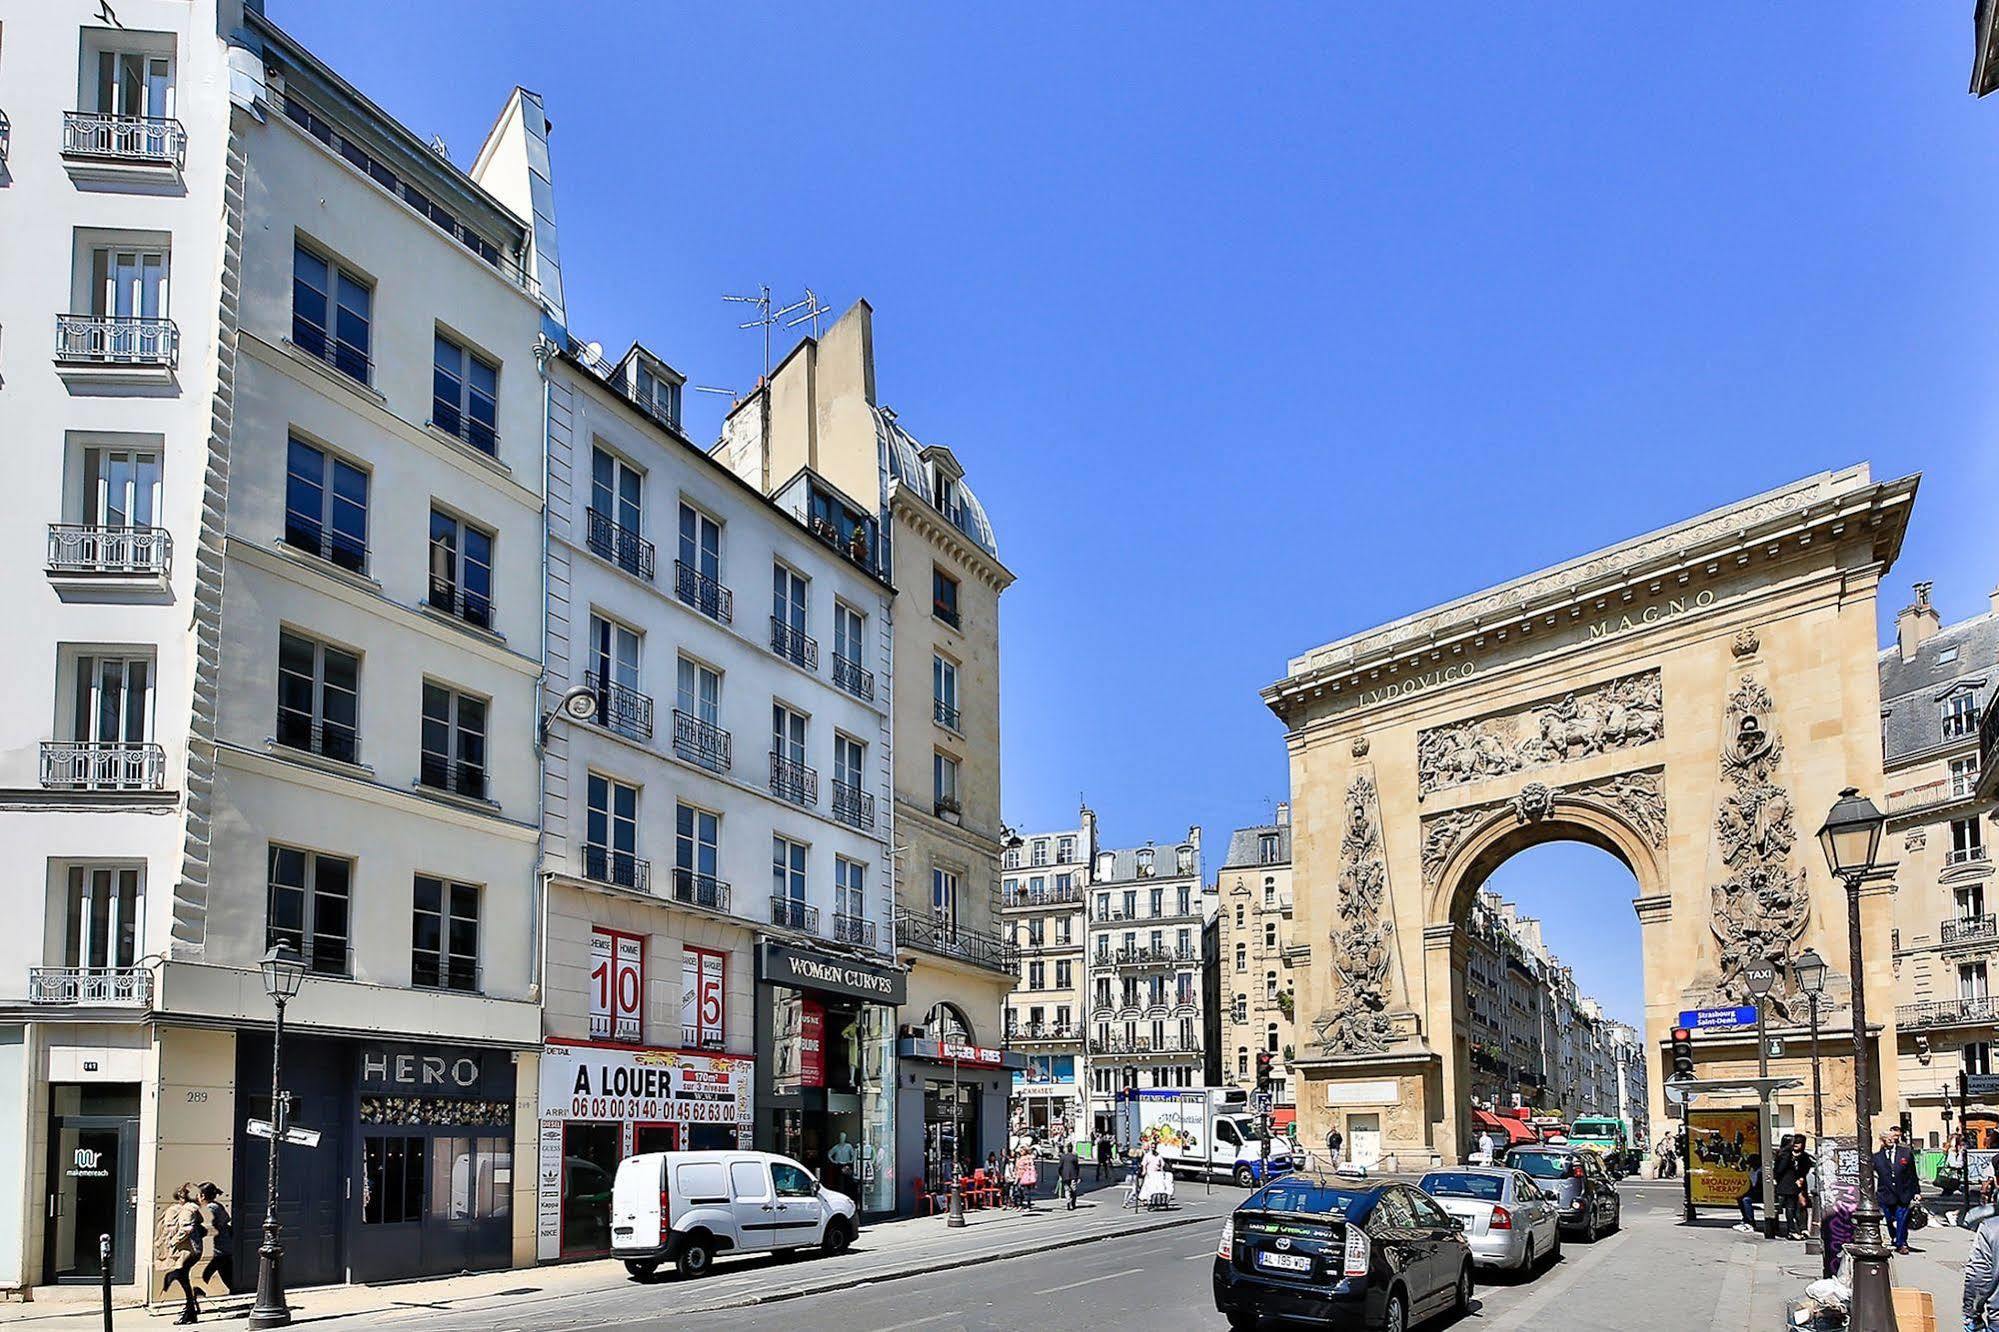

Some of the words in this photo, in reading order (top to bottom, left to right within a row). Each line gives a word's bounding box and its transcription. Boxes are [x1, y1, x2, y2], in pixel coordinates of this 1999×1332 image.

[1588, 589, 1714, 641] MAGNO
[788, 957, 843, 983] WOMEN
[844, 970, 892, 994] CURVES
[1747, 969, 1772, 980] TAXI
[1697, 1010, 1736, 1019] Strasbourg
[1697, 1017, 1738, 1026] Saint-Denis
[364, 1053, 479, 1086] HERO
[573, 1064, 592, 1096] A
[602, 1066, 671, 1099] LOUER
[683, 1083, 694, 1091] sur
[696, 1082, 702, 1091] 3
[704, 1084, 729, 1093] niveaux
[187, 1091, 208, 1103] 289
[572, 1097, 588, 1117] 06
[592, 1098, 606, 1118] 03
[610, 1099, 624, 1118] 00
[628, 1100, 640, 1118] 31
[678, 1102, 690, 1120] 45
[693, 1103, 706, 1121] 62
[709, 1104, 721, 1121] 63
[723, 1104, 736, 1121] 00
[1701, 1178, 1748, 1186] BROADWAY
[1709, 1185, 1740, 1193] THERAPY
